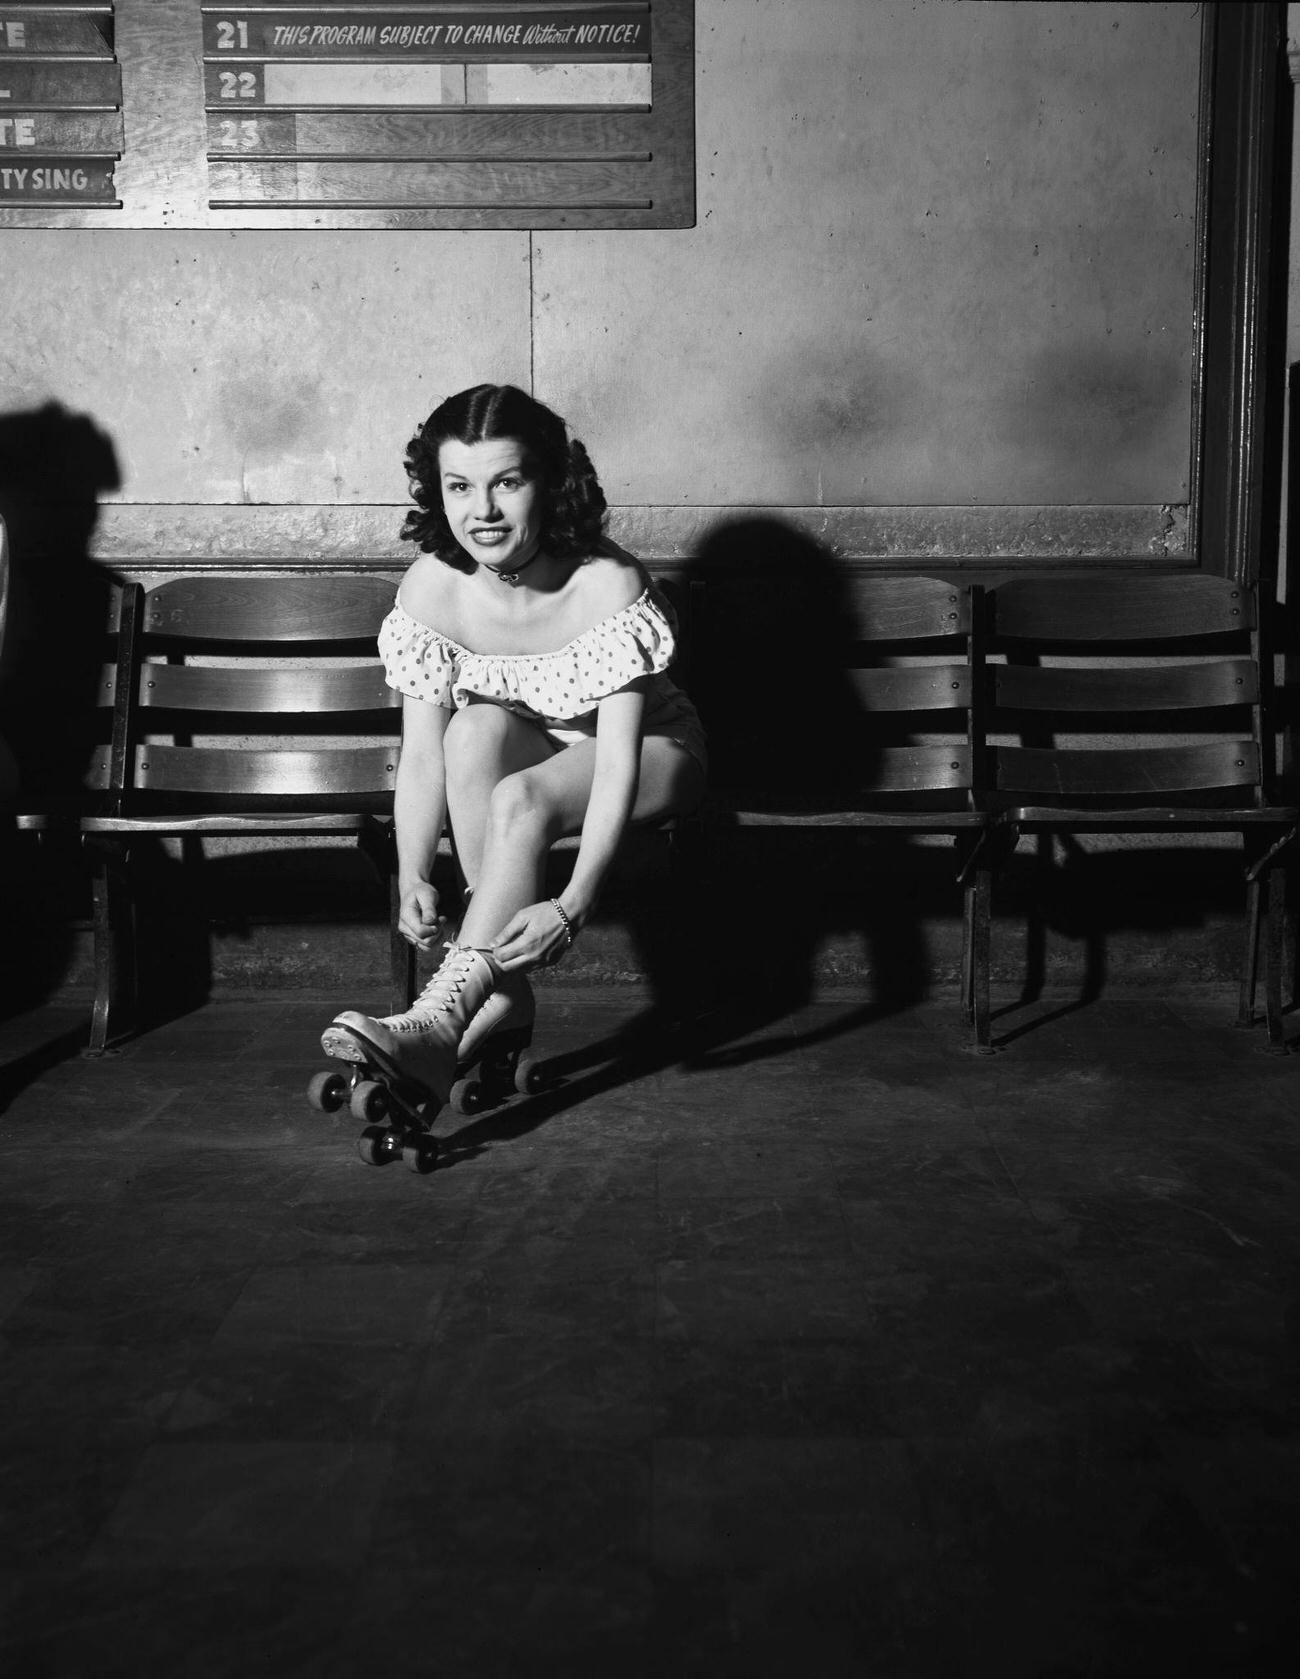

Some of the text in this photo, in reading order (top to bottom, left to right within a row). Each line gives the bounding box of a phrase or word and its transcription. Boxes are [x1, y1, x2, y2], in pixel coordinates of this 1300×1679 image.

[216, 20, 248, 49] 21
[273, 23, 640, 48] THIS PROGRAM SUBJECT TO CHANGE Without NOTICE!
[218, 71, 257, 98] 22
[219, 120, 261, 147] 23
[1, 167, 89, 191] TY SING
